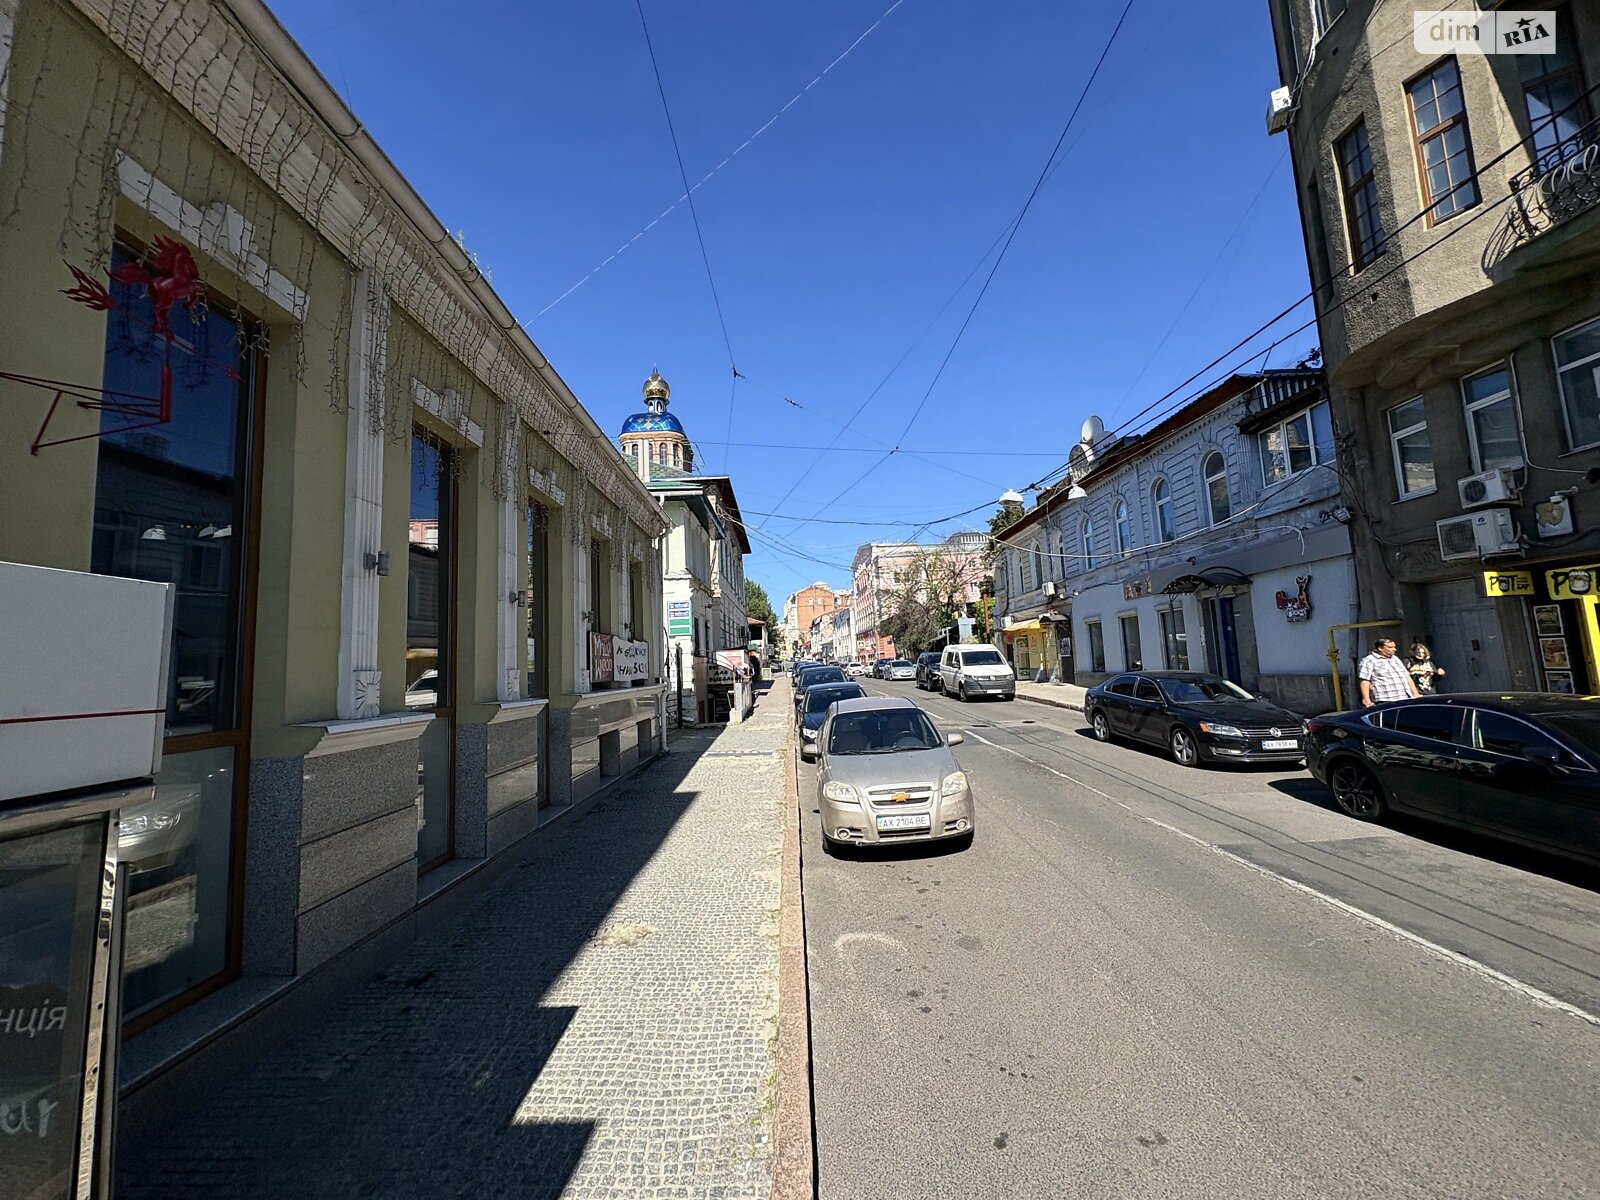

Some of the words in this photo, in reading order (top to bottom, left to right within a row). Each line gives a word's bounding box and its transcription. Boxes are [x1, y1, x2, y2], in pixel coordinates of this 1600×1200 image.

[882, 819, 894, 828] AX
[896, 817, 914, 827] 2104
[915, 816, 927, 825] BE
